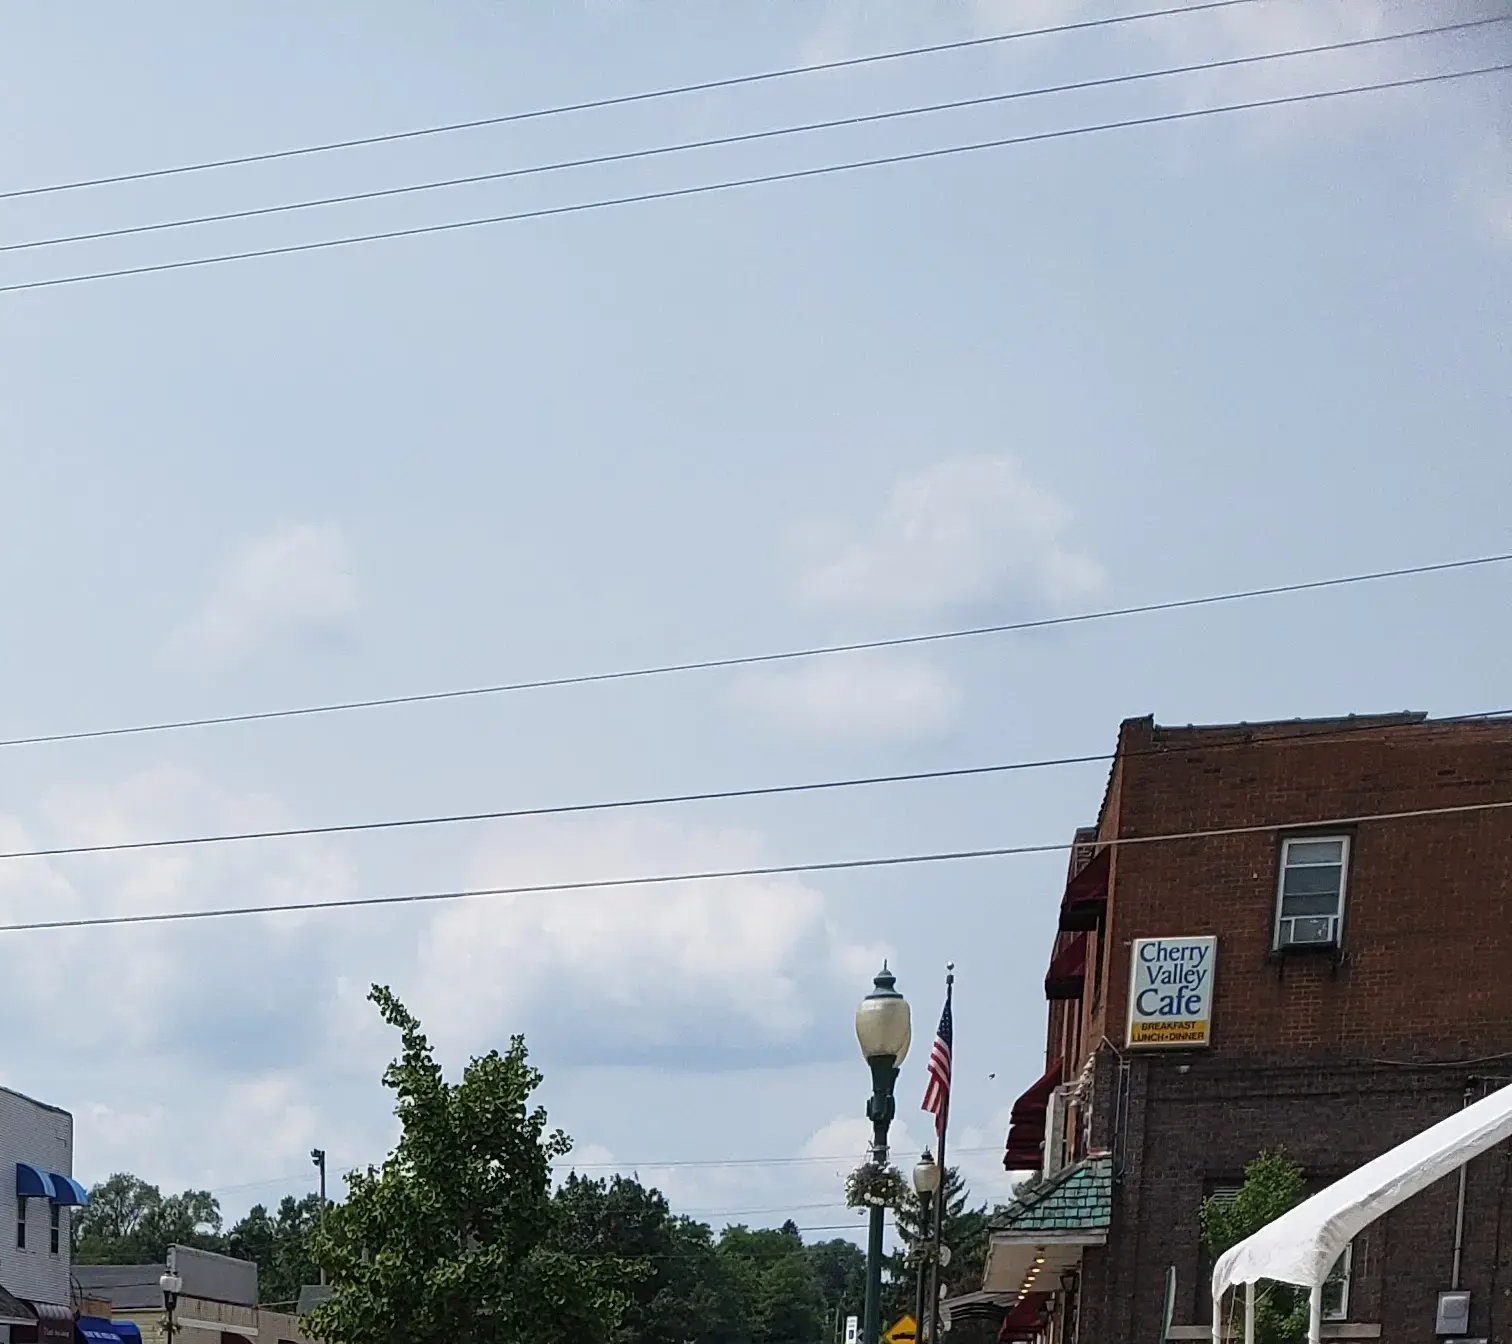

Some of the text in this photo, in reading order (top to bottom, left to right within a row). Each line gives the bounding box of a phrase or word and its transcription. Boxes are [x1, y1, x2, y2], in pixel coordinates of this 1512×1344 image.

[1140, 941, 1209, 968] Cherry
[1146, 963, 1208, 991] Valley
[1136, 985, 1201, 1016] Cafe
[1141, 1021, 1196, 1031] BREAKFAST
